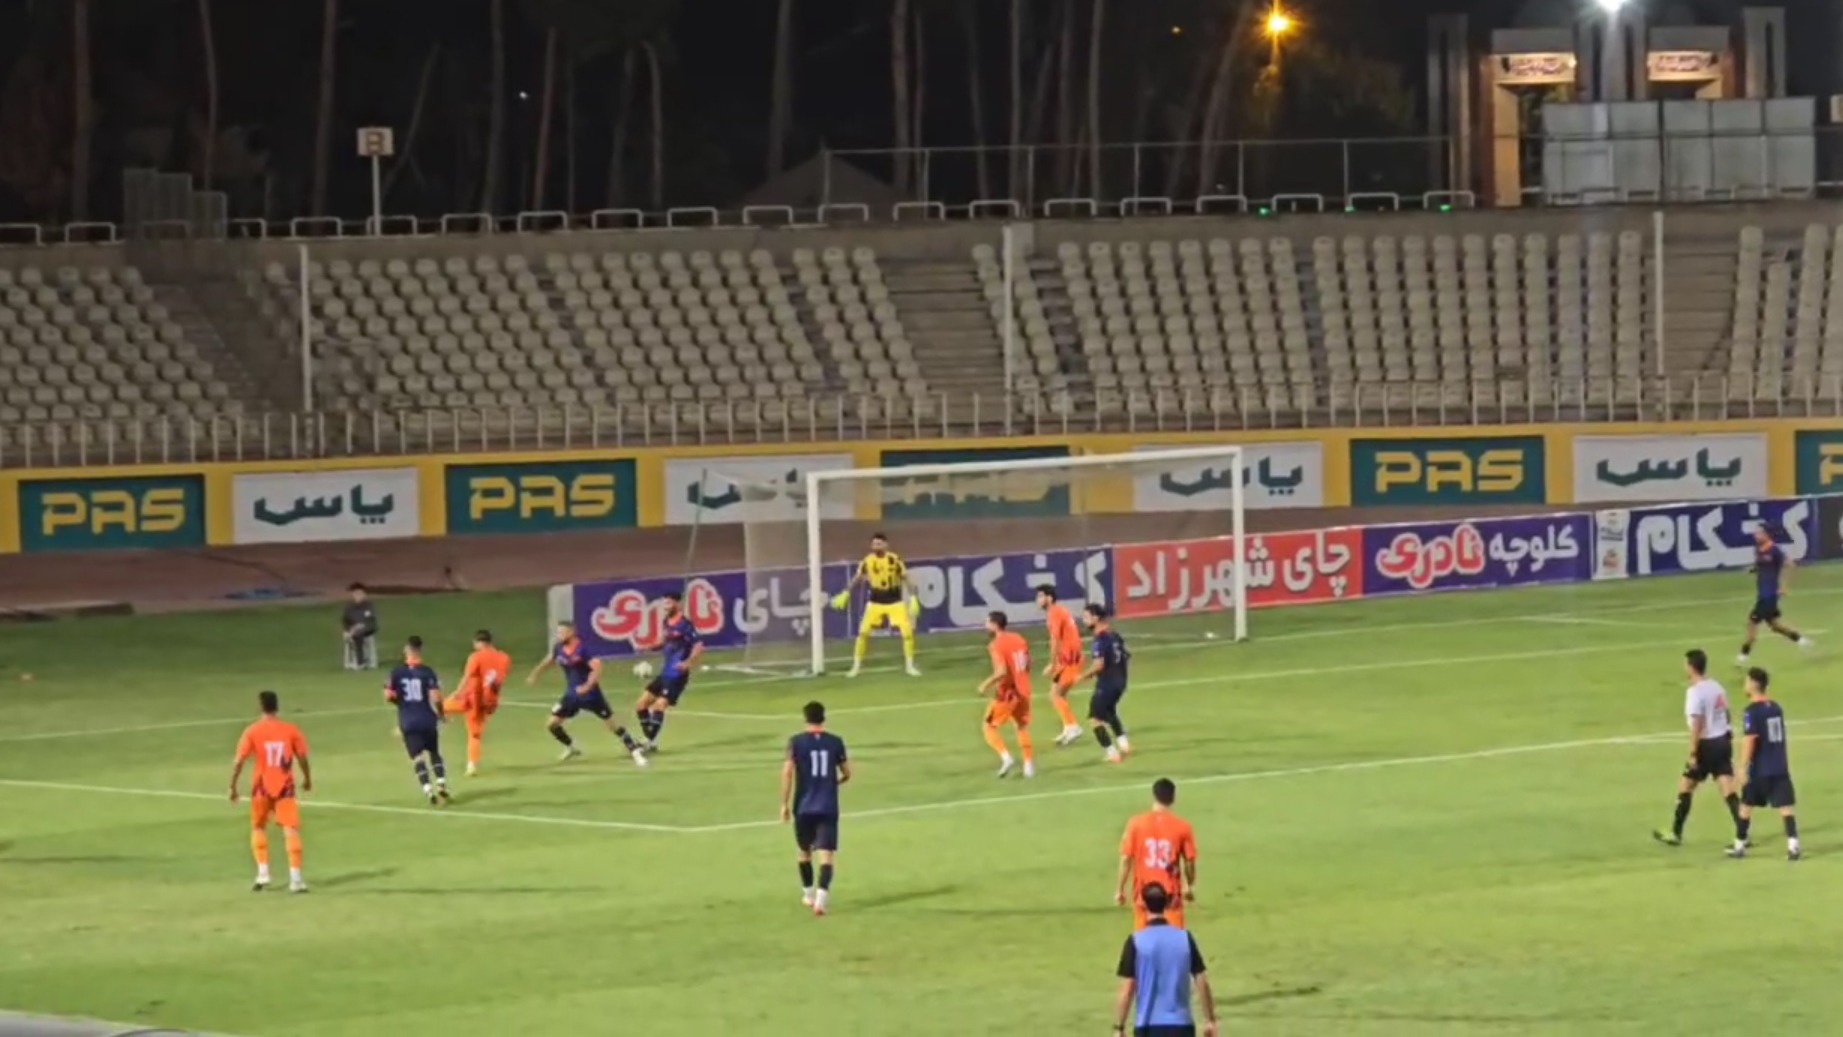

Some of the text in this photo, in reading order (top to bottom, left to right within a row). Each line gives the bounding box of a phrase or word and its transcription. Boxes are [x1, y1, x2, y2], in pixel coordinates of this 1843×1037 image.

[1160, 456, 1303, 497] پاس
[1375, 450, 1523, 493] PAS
[1597, 448, 1744, 487] پاس
[41, 488, 185, 535] PAS
[253, 484, 394, 526] پاس
[469, 474, 615, 519] PAS
[1127, 531, 1350, 612] چای شهرزاد
[1376, 523, 1579, 588] کلوچه نادری
[401, 678, 423, 702] 30
[263, 741, 286, 768] 17
[810, 749, 828, 777] 11
[1145, 837, 1172, 869] 33
